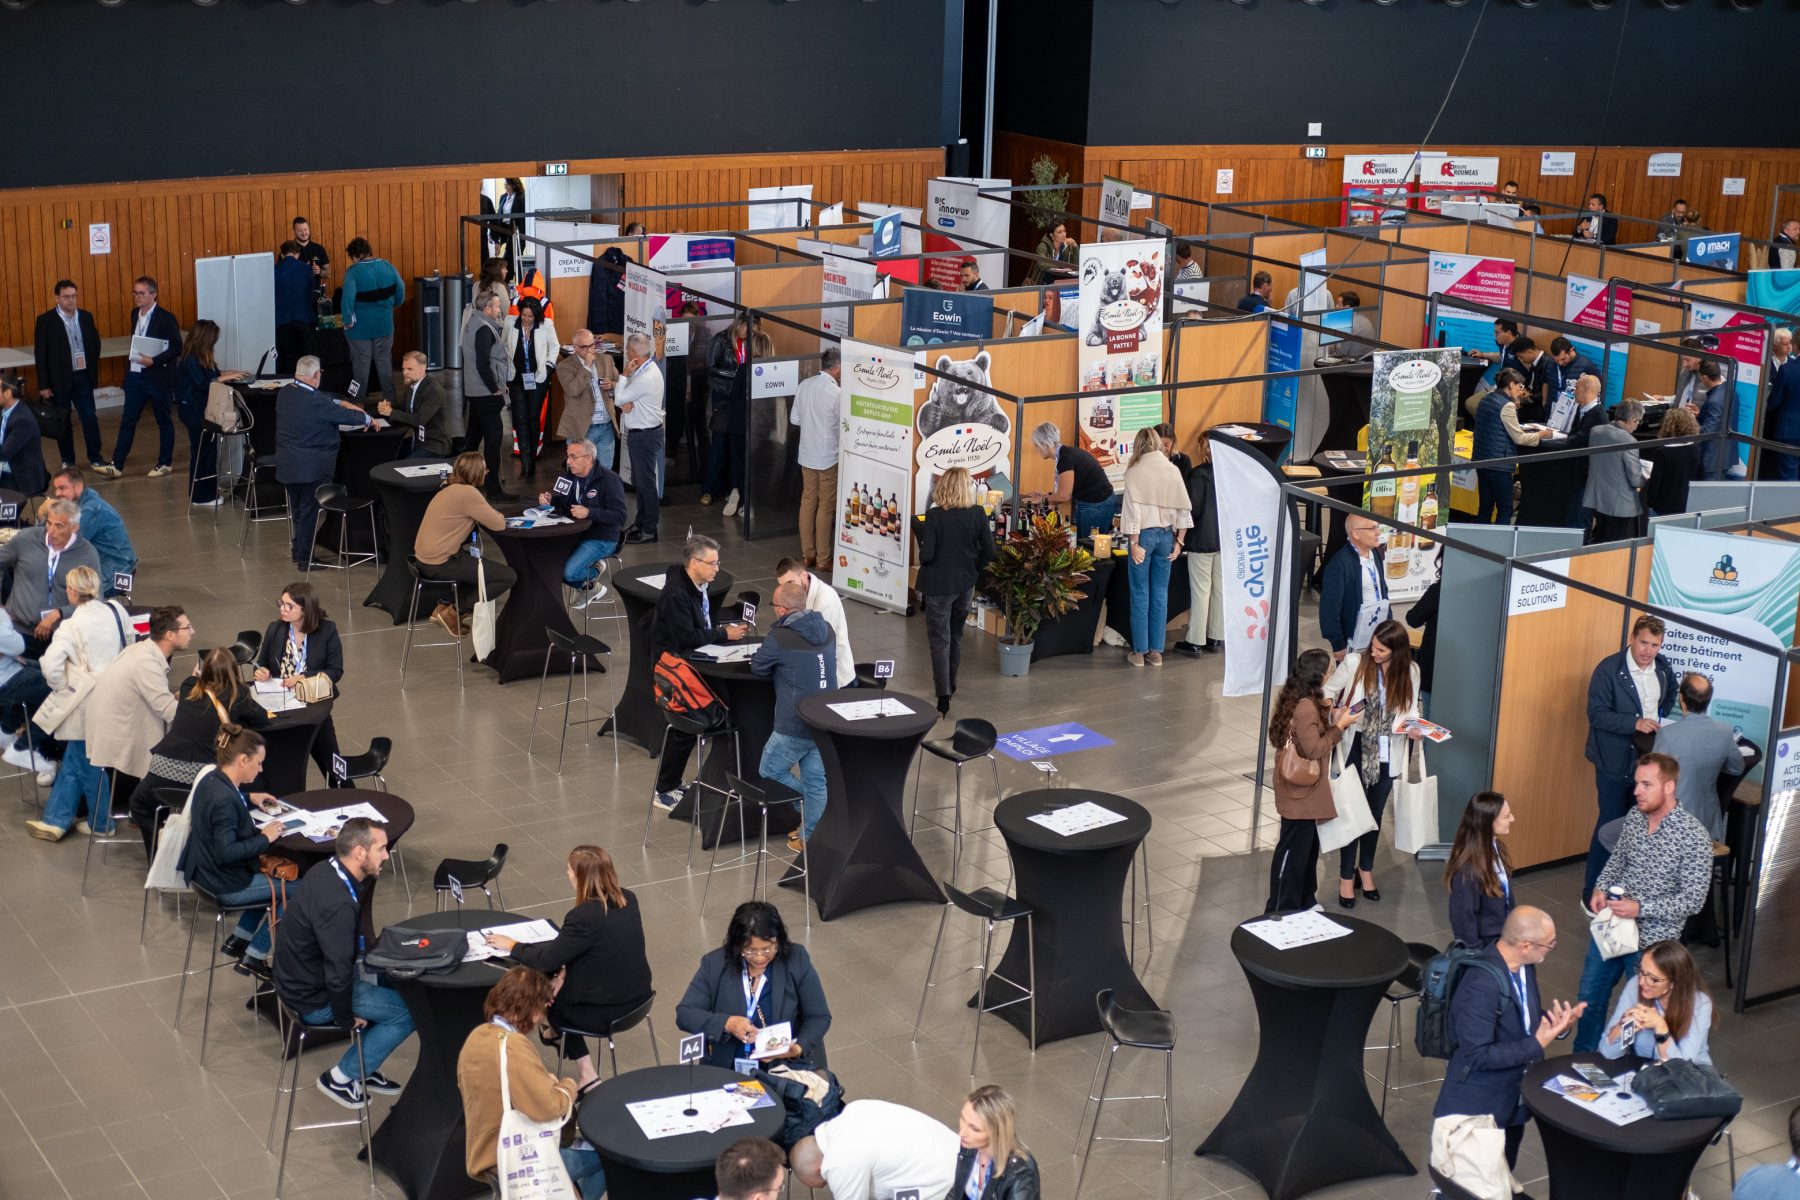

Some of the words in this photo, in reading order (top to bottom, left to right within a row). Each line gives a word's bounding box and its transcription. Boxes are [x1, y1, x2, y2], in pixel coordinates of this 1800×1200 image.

[1477, 271, 1511, 280] FORMATION
[1455, 283, 1510, 295] PROFESSIONNELLE
[1480, 279, 1510, 287] CONTINUE
[933, 311, 962, 323] Eowin
[1117, 332, 1137, 341] BONNE
[855, 400, 881, 410] AGITATEUR
[925, 440, 961, 458] Emile
[558, 482, 569, 490] B9
[1375, 484, 1393, 493] Olive
[3, 508, 14, 516] A9
[117, 577, 128, 586] A8
[1708, 579, 1739, 587] ECOLOGIK
[1521, 581, 1557, 595] ECOLOGIK
[1517, 593, 1558, 608] SOLUTIONS
[745, 607, 753, 618] B7
[1690, 644, 1743, 662] bâtiment
[817, 653, 826, 679] FAUCHÉ
[878, 664, 890, 673] B6
[1666, 657, 1686, 666] ans
[1687, 656, 1711, 668] l'ère
[1712, 662, 1727, 673] de
[998, 737, 1037, 756] EMPLOI
[1011, 734, 1052, 755] VILLAGE
[335, 761, 345, 773] A6
[684, 1043, 700, 1056] A4
